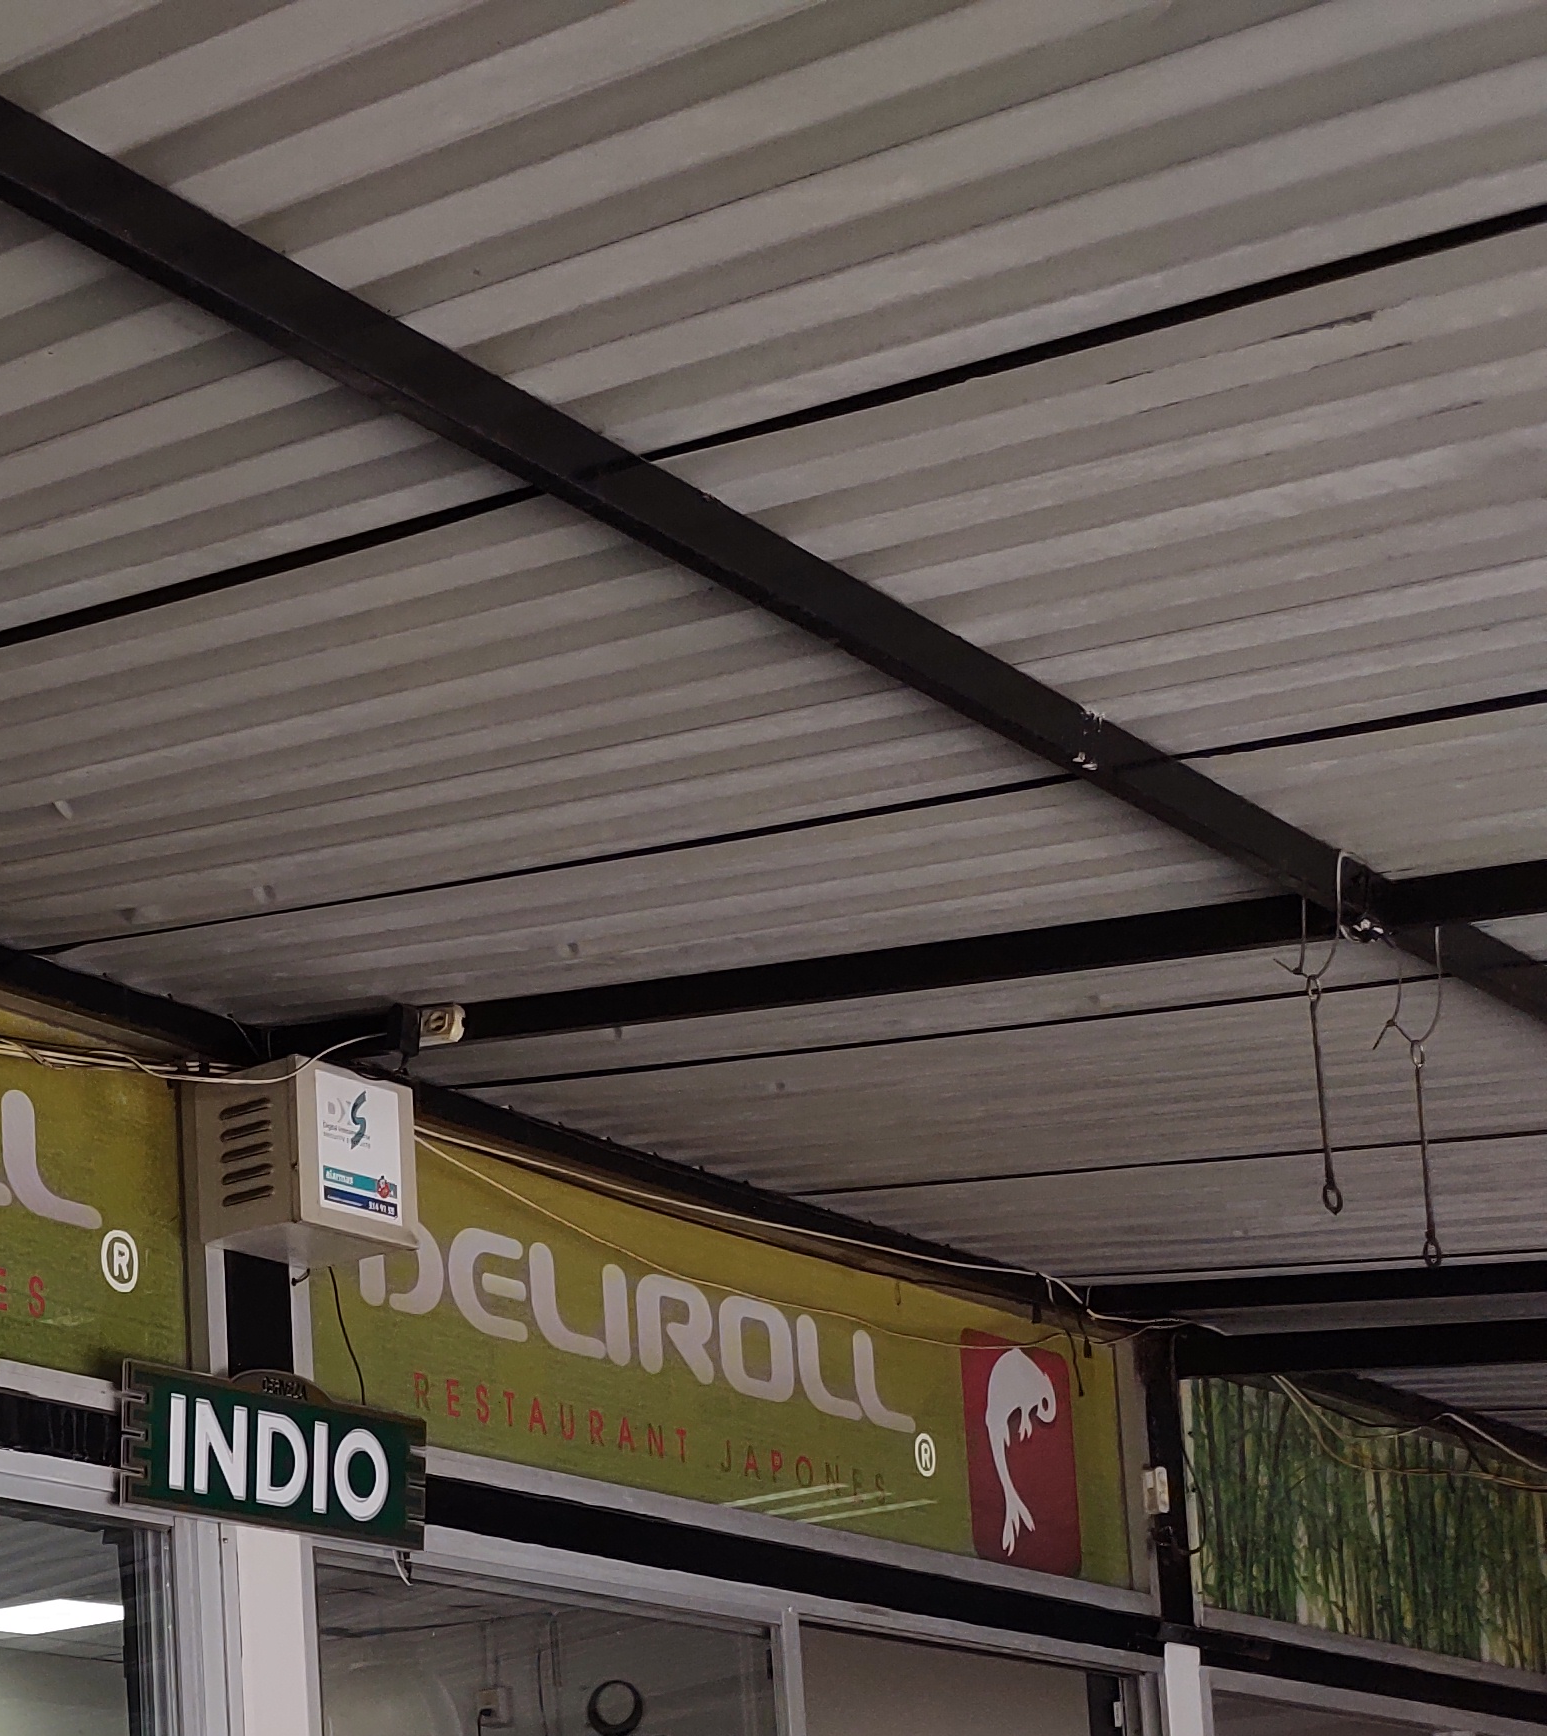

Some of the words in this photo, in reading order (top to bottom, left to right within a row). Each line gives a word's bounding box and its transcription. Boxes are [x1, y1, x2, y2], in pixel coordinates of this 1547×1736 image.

[359, 1222, 916, 1433] DELIROLL
[168, 1392, 391, 1522] INDIO
[413, 1371, 687, 1464] RESTAURANT
[720, 1440, 886, 1504] JAPONES
